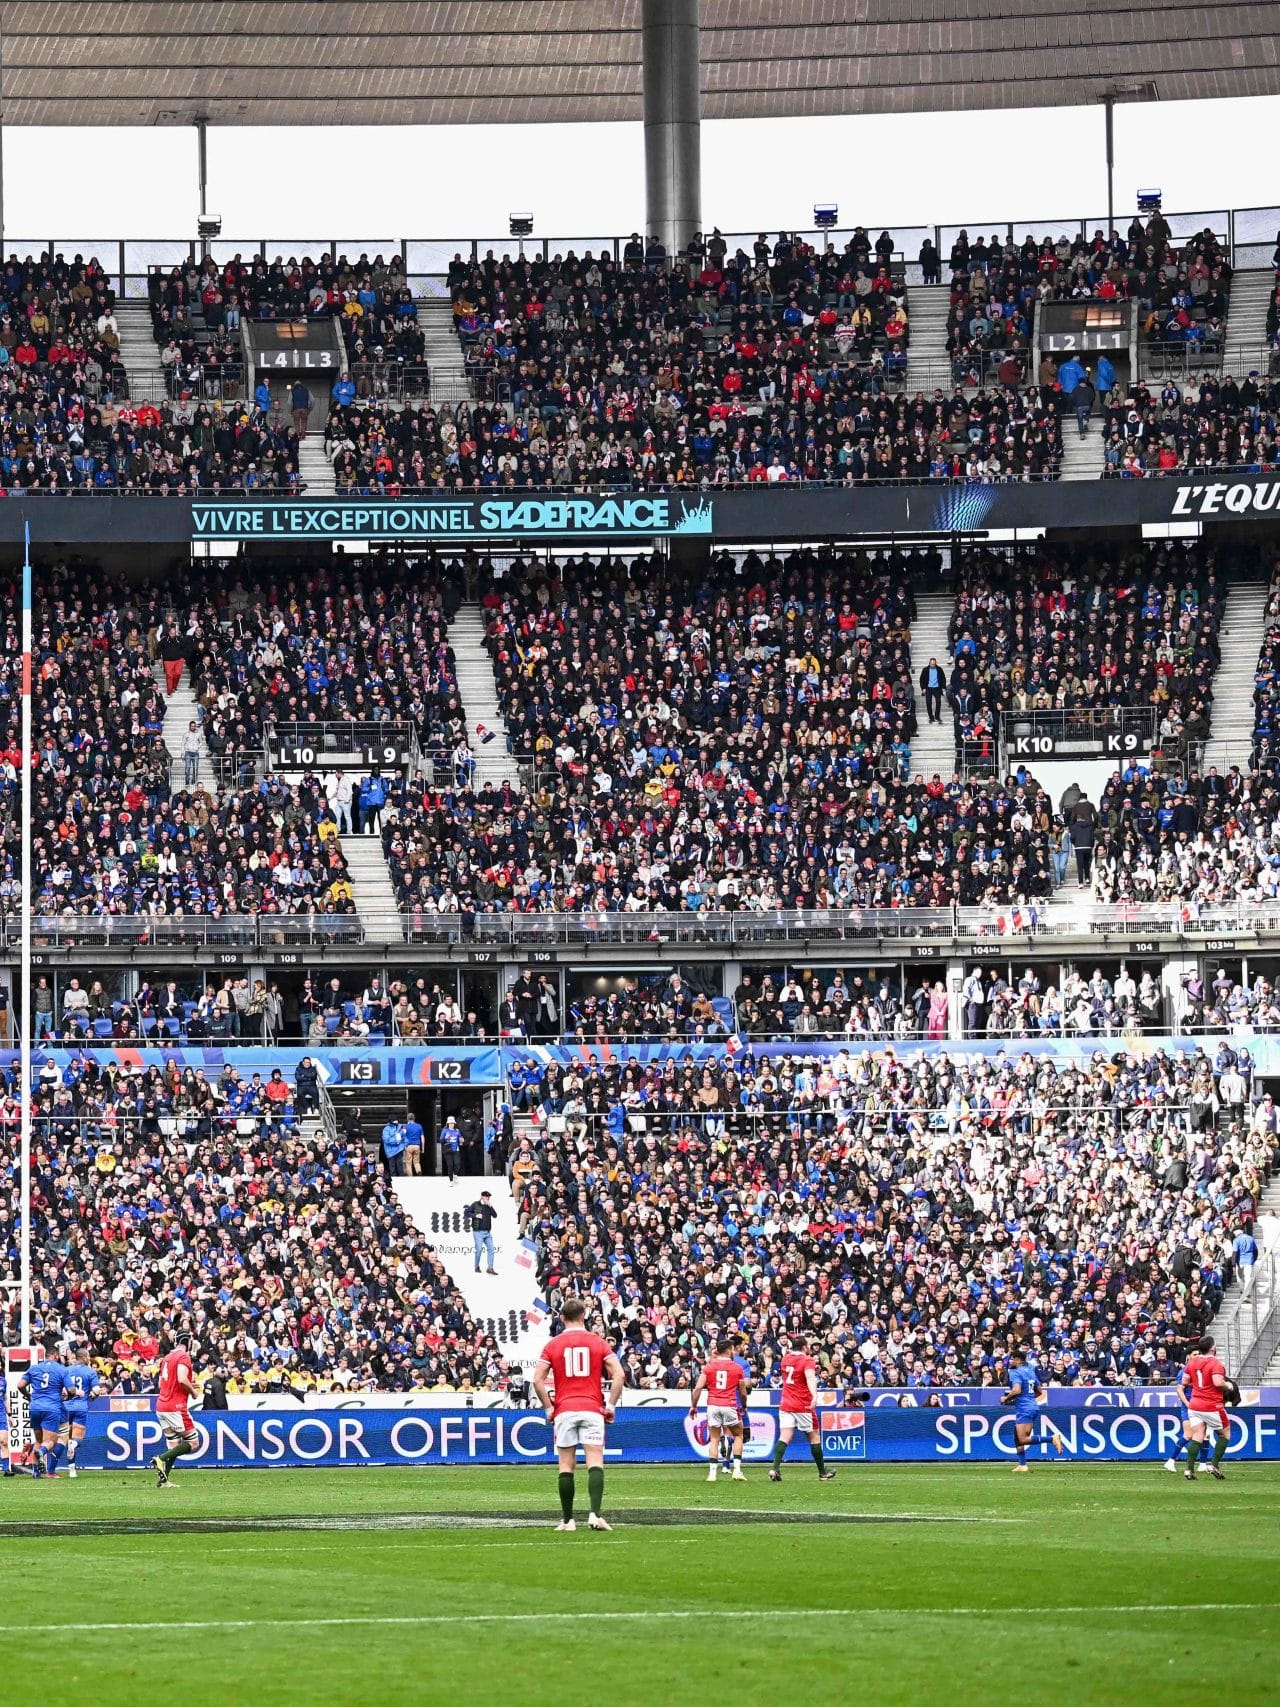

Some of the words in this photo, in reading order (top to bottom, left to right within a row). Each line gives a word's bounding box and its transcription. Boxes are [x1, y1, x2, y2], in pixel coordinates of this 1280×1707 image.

[192, 510, 264, 531] VIVRE
[272, 509, 475, 531] L'EXCEPTIONNEL
[917, 947, 934, 956] 105
[1135, 943, 1153, 952] 104
[220, 954, 237, 962] 109
[280, 954, 296, 962] 108
[474, 952, 490, 961] 107
[533, 952, 550, 961] 106
[350, 1063, 373, 1079] K3
[438, 1062, 462, 1079] K2
[563, 1346, 590, 1378] 10
[39, 1373, 50, 1389] 3
[716, 1371, 728, 1390] 9
[785, 1366, 795, 1385] 2
[1196, 1369, 1203, 1388] 1
[9, 1390, 20, 1448] SOCIETE
[825, 1435, 862, 1451] GMF
